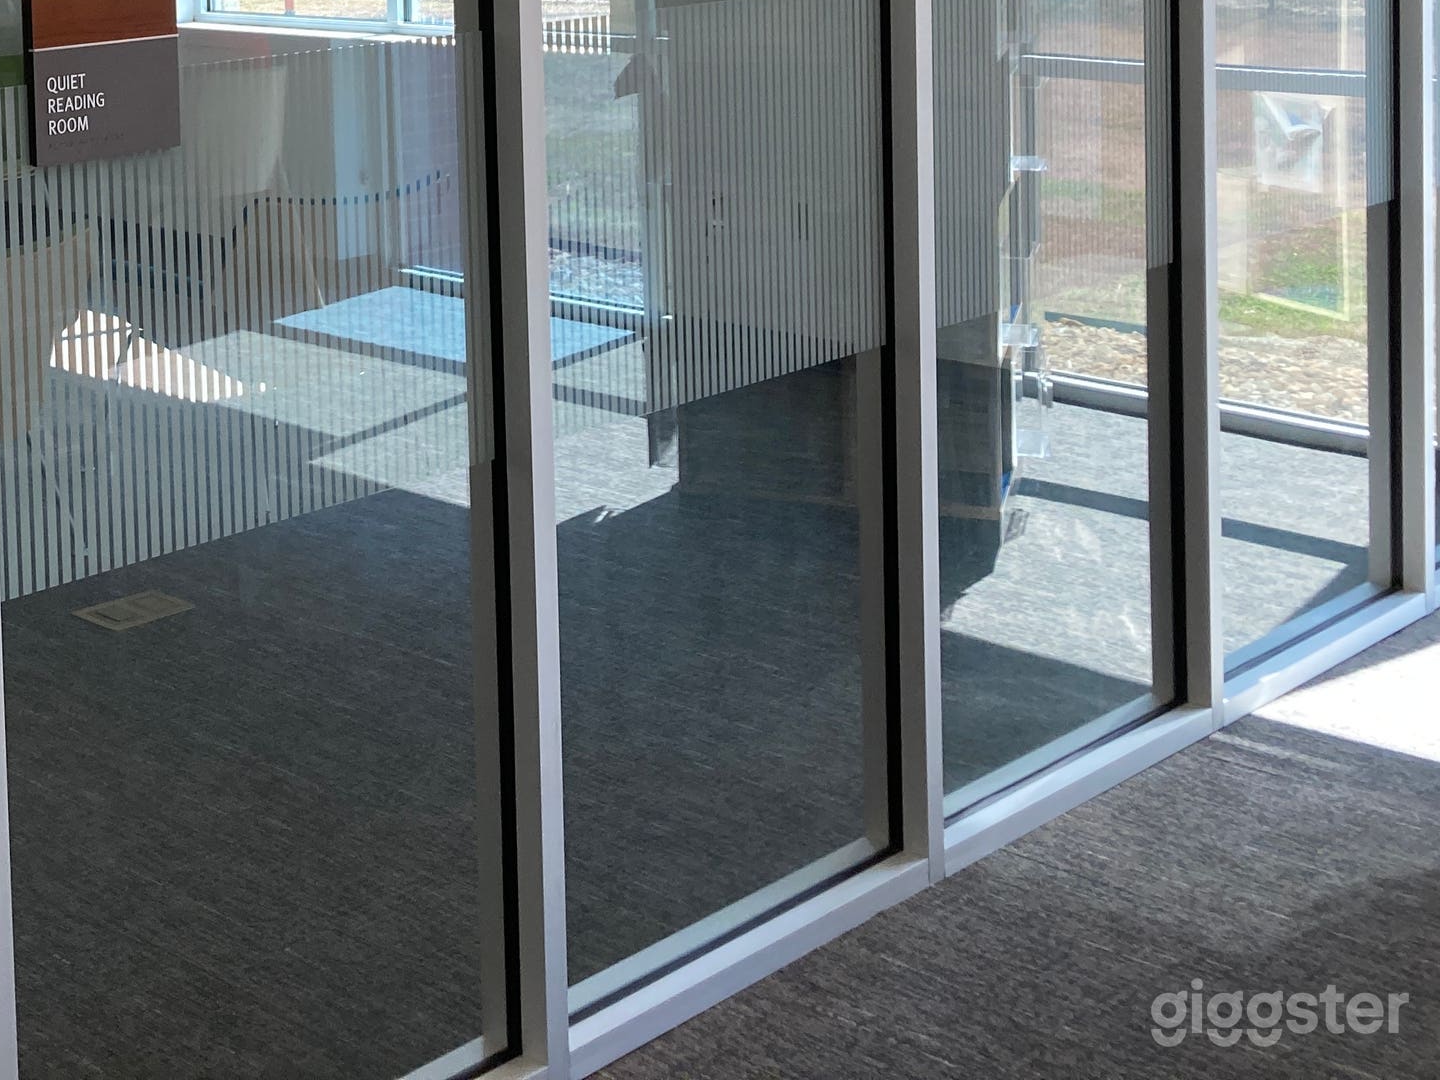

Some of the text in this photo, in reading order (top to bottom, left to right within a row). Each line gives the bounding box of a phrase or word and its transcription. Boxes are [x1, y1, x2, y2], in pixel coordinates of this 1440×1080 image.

[47, 73, 86, 94] QUIET
[48, 92, 105, 114] READING
[49, 116, 89, 135] ROOM
